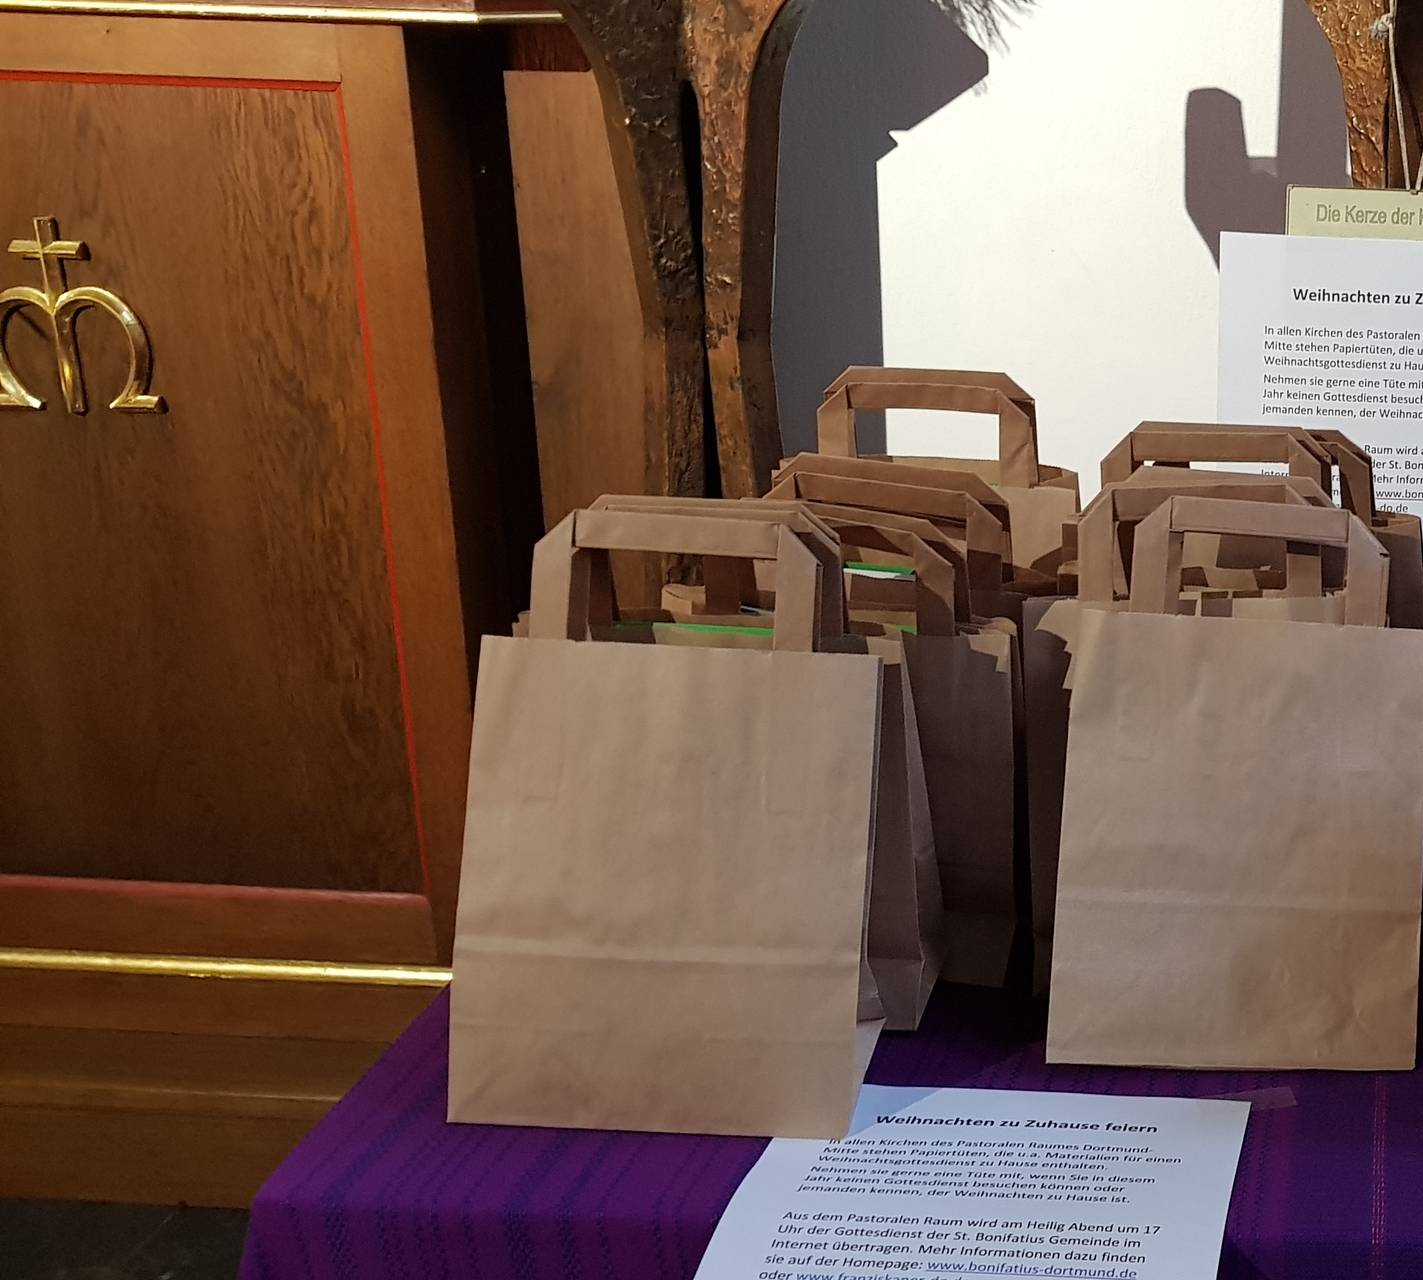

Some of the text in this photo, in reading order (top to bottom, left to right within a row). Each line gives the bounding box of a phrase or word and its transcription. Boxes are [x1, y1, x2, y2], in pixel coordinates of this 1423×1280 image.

[1315, 203, 1341, 223] Die
[1344, 204, 1387, 225] Kerze
[1390, 206, 1415, 226] der
[1293, 288, 1390, 303] Weihnachten
[1394, 295, 1410, 303] zu
[1264, 325, 1274, 335] In
[1277, 326, 1301, 335] allen
[1304, 326, 1342, 337] Kirchen
[1345, 328, 1363, 338] des
[1366, 328, 1420, 339] Pastoralen
[1264, 340, 1292, 350] Mitte
[1295, 341, 1329, 351] stehen
[1332, 342, 1395, 356] Papiertüten,
[1398, 344, 1414, 354] die
[1264, 355, 1387, 369] Weihnachtsgottesdienst
[1263, 374, 1306, 384] Nehmen
[1309, 375, 1323, 385] sie
[1326, 379, 1355, 388] gerne
[1358, 377, 1380, 387] eine
[1384, 378, 1405, 388] Tüte
[1263, 389, 1284, 399] Jahr
[1286, 389, 1320, 400] keinen
[1323, 391, 1387, 402] Gottesdienst
[1262, 403, 1313, 415] jemanden
[1316, 405, 1356, 418] kennen,
[1359, 407, 1376, 416] der
[1364, 444, 1392, 454] Raum
[1395, 445, 1417, 454] wird
[1388, 459, 1401, 469] St.
[875, 1114, 995, 1126] Weihnachten
[1024, 1119, 1100, 1129] Zuhause
[1104, 1122, 1158, 1131] feiern
[834, 1175, 881, 1183] keinen
[882, 1177, 970, 1186] Gottesdienst
[971, 1180, 1037, 1188] besuchen
[1039, 1182, 1091, 1190] können
[797, 1184, 866, 1192] jemanden
[952, 1189, 1044, 1199] Weihnachten
[1064, 1193, 1108, 1201] Hause
[783, 1210, 809, 1219] Aus
[812, 1212, 843, 1220] dem
[847, 1213, 920, 1223] Pastoralen
[923, 1216, 963, 1225] Raum
[966, 1218, 998, 1227] wird
[1026, 1220, 1066, 1231] Heilig
[1068, 1222, 1114, 1231] Abend
[1144, 1225, 1159, 1233] 17
[777, 1224, 1141, 1247] Uhr der Gottesdienst der St. Bonifatius Gemeinde im
[771, 1238, 1146, 1262] Internet übertragen. Mehr Informationen dazu finden
[764, 1254, 1138, 1277] sie auf der Homepage: www.bonifatius-dortmund.de
